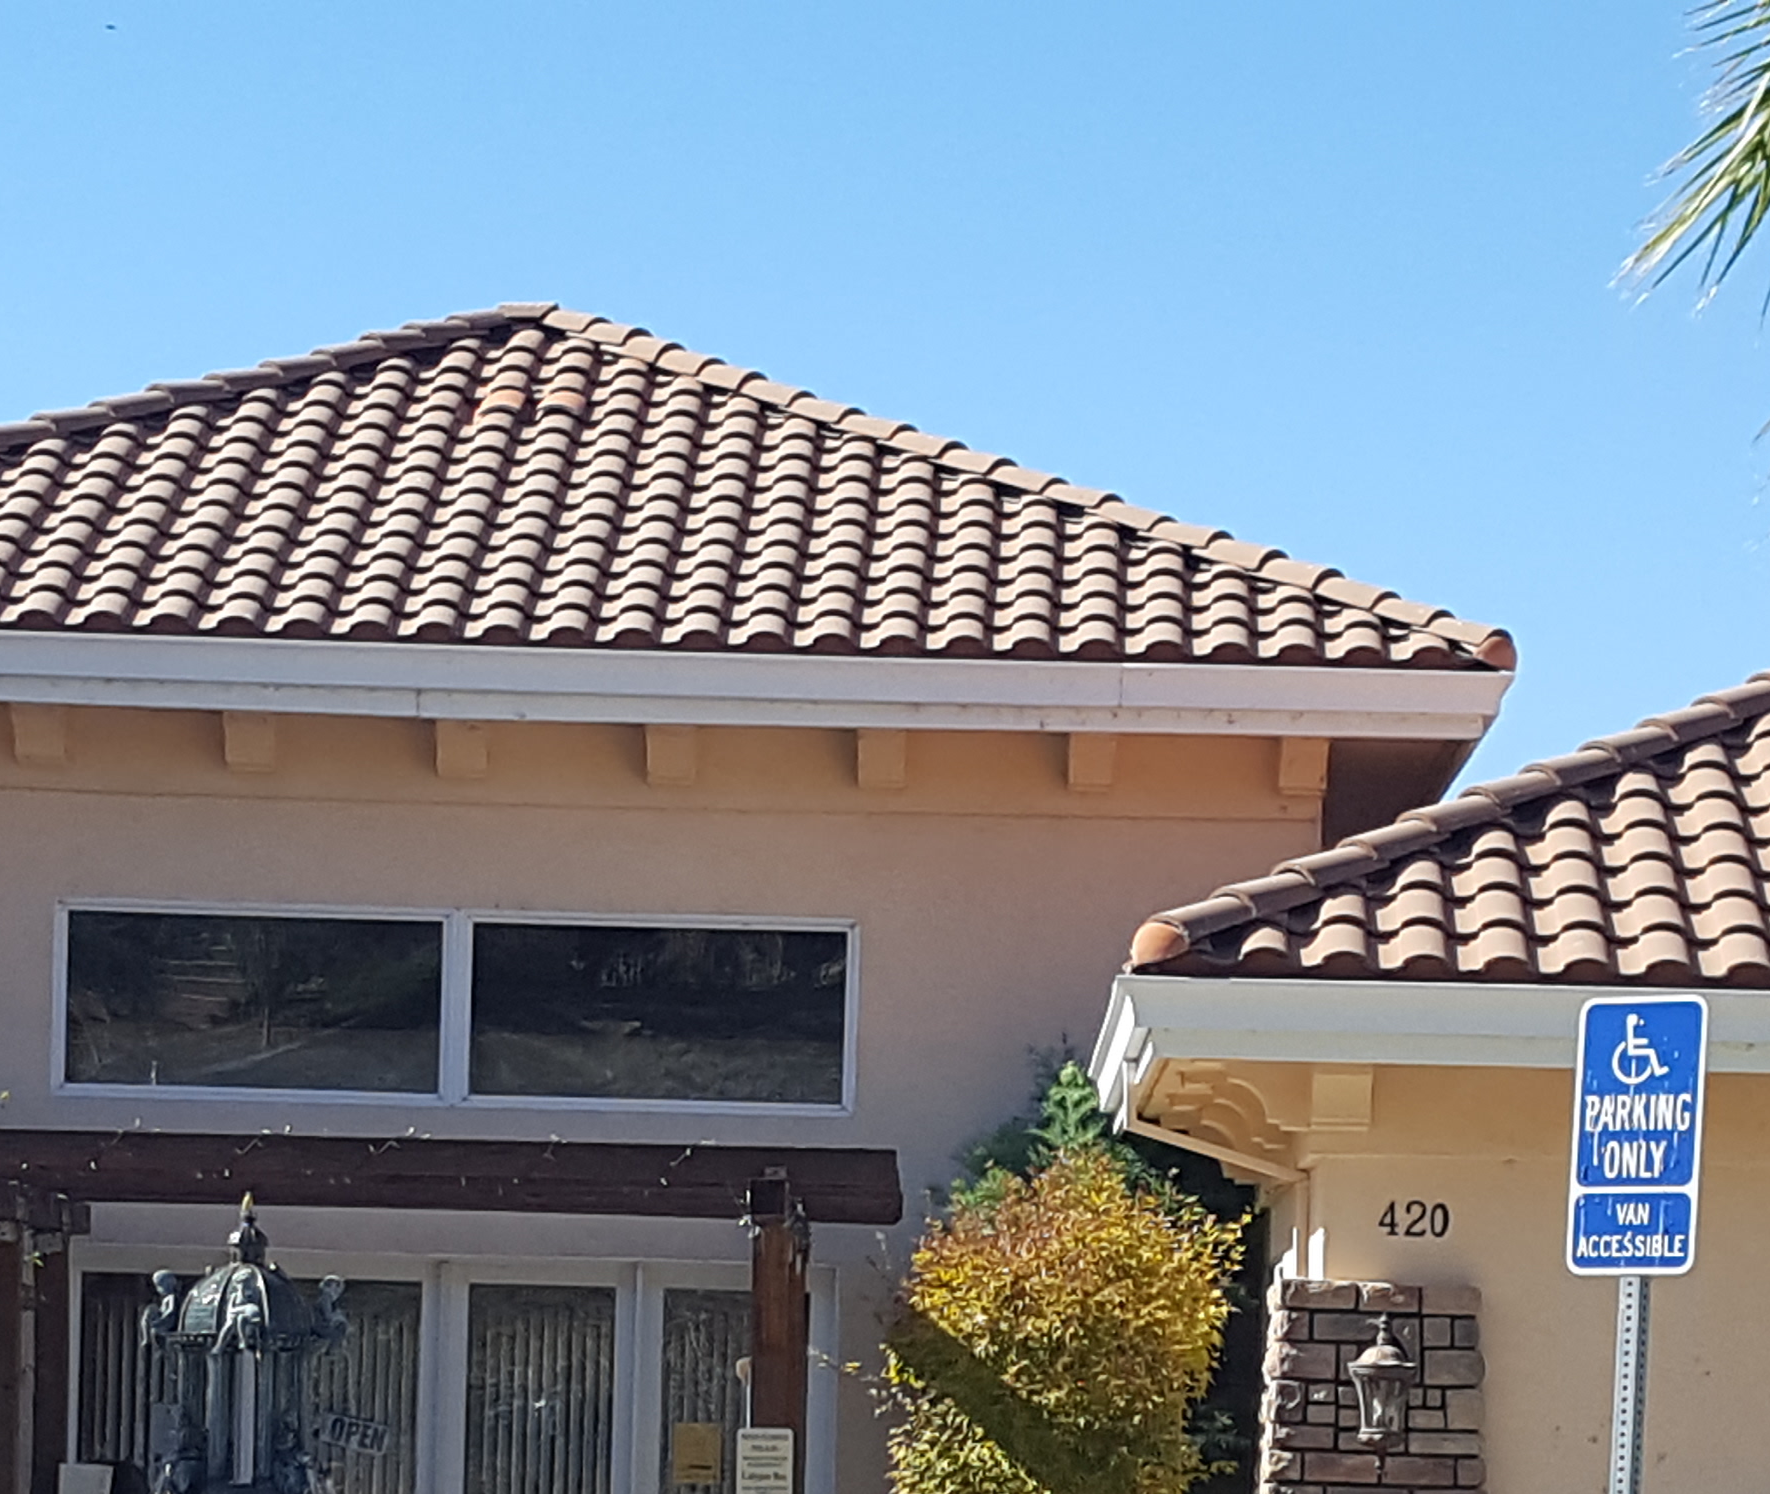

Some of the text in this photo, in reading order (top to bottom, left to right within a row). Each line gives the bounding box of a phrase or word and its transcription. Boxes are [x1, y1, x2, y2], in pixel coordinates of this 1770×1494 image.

[1585, 1094, 1692, 1132] PARKING
[1603, 1140, 1667, 1179] ONLY
[1378, 1200, 1450, 1237] 420
[1616, 1203, 1650, 1225] VAN
[1577, 1235, 1685, 1258] ACCESSIBLE
[331, 1417, 387, 1452] OPEN
